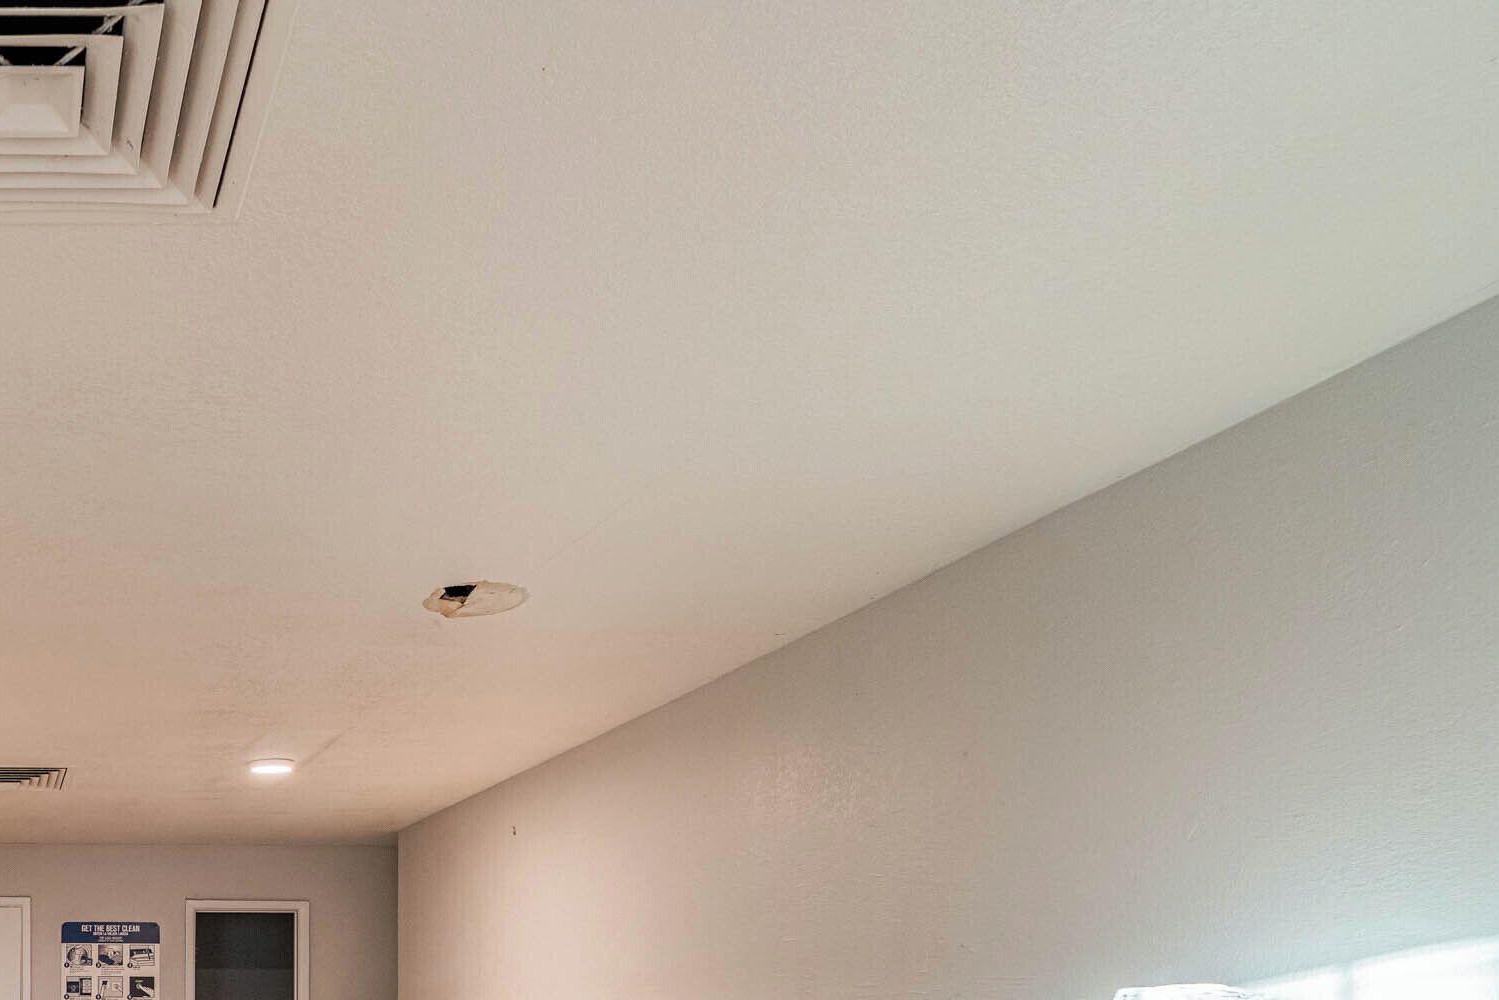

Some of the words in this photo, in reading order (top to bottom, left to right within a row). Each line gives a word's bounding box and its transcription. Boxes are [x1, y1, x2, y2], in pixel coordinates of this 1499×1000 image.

[81, 924, 92, 933] GET
[94, 924, 105, 933] THE
[105, 924, 121, 933] BEST
